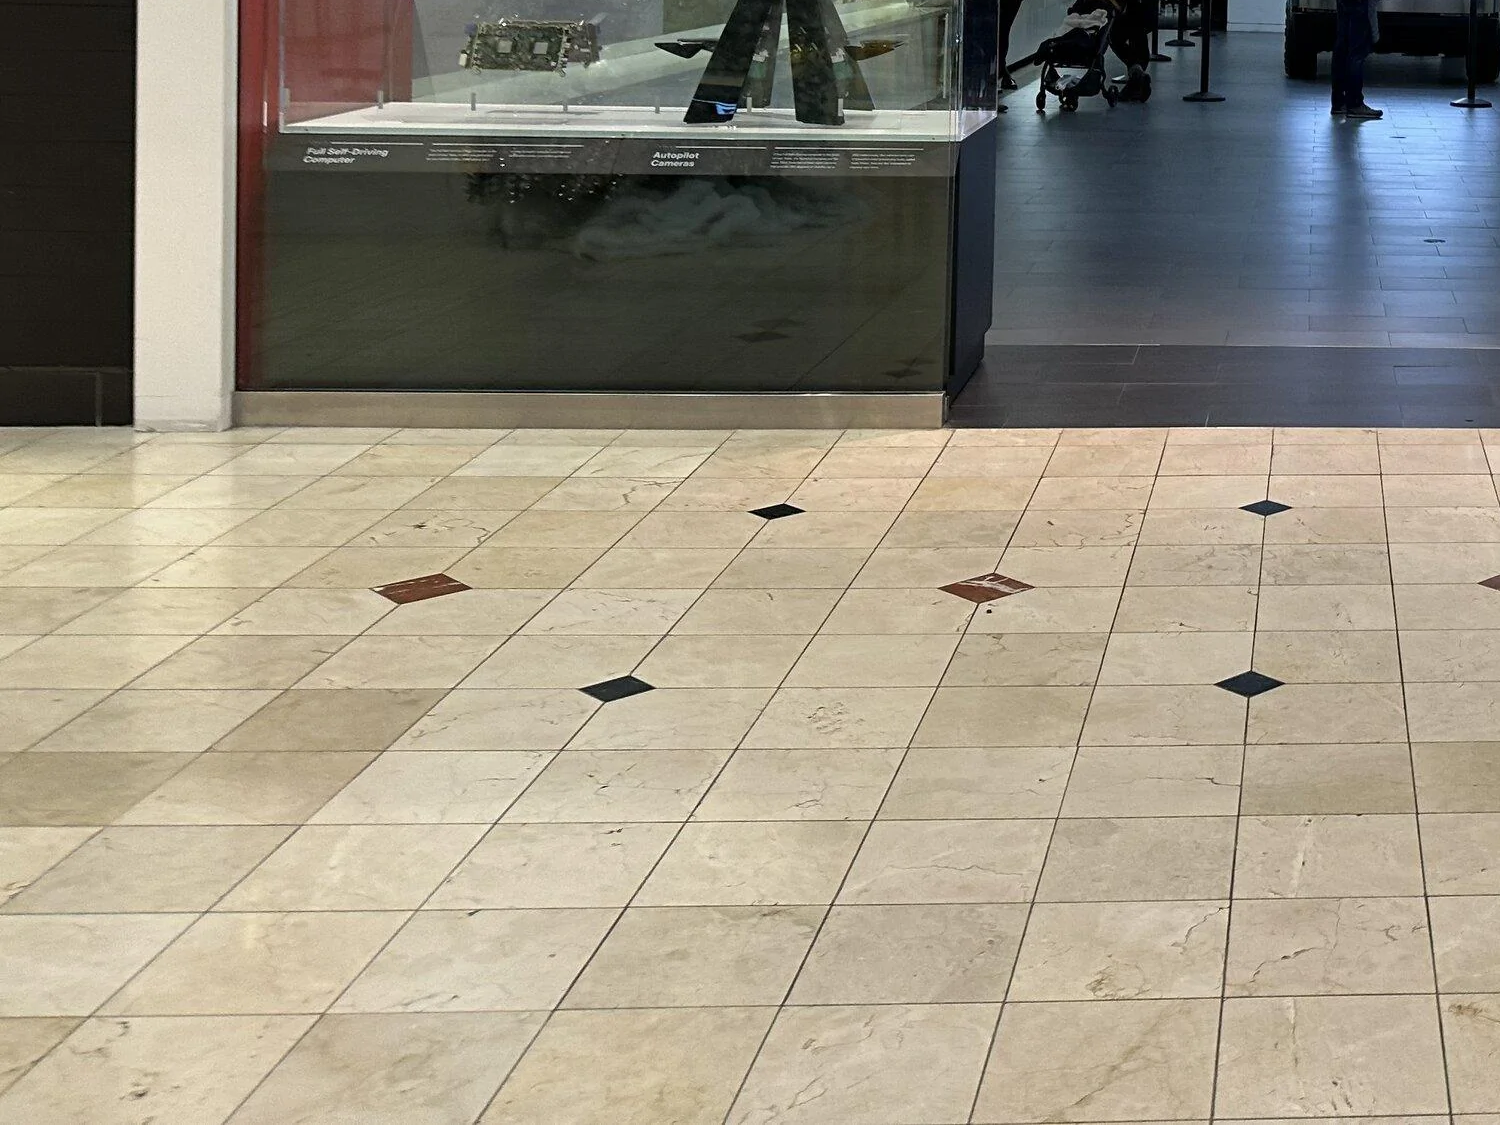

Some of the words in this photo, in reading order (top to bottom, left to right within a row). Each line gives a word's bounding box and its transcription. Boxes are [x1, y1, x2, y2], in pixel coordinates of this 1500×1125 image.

[327, 147, 389, 157] Self-Driving
[652, 151, 699, 160] Autopilot
[303, 155, 355, 164] Computer
[651, 159, 695, 167] Cameras
